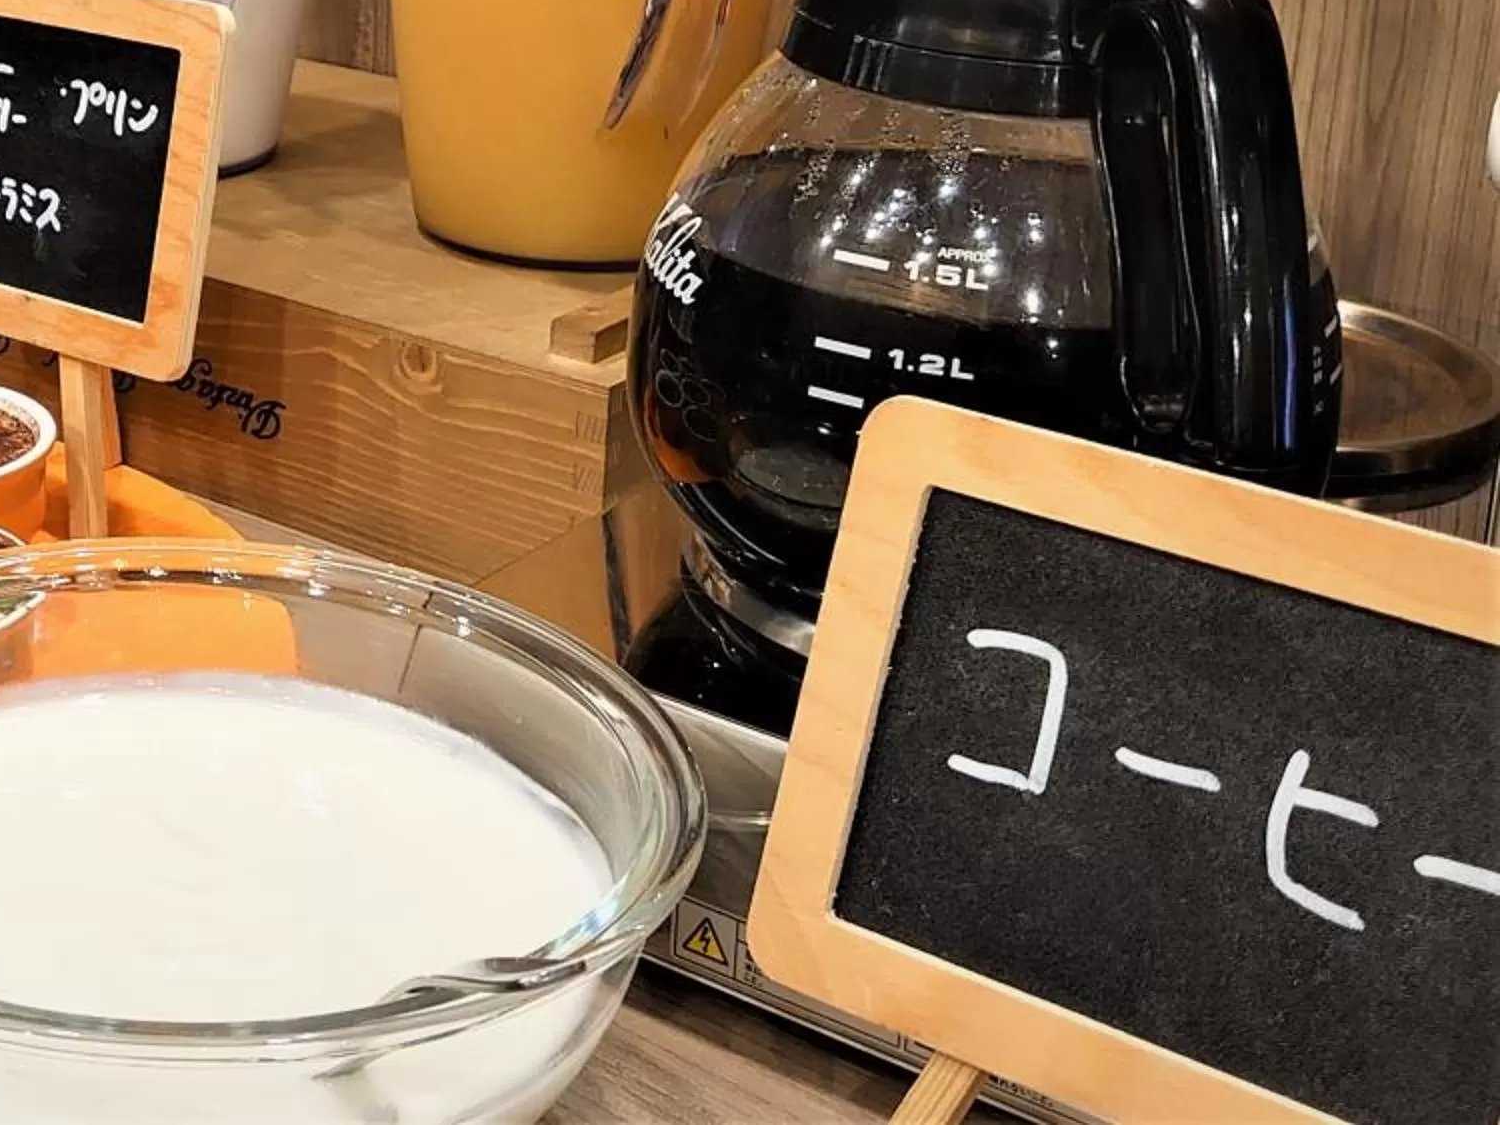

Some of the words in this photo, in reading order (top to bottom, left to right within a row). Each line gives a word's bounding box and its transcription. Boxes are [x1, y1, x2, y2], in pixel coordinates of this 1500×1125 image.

[644, 191, 704, 305] Kalita
[168, 358, 288, 440] Vintag
[947, 628, 1500, 931] コーヒー
